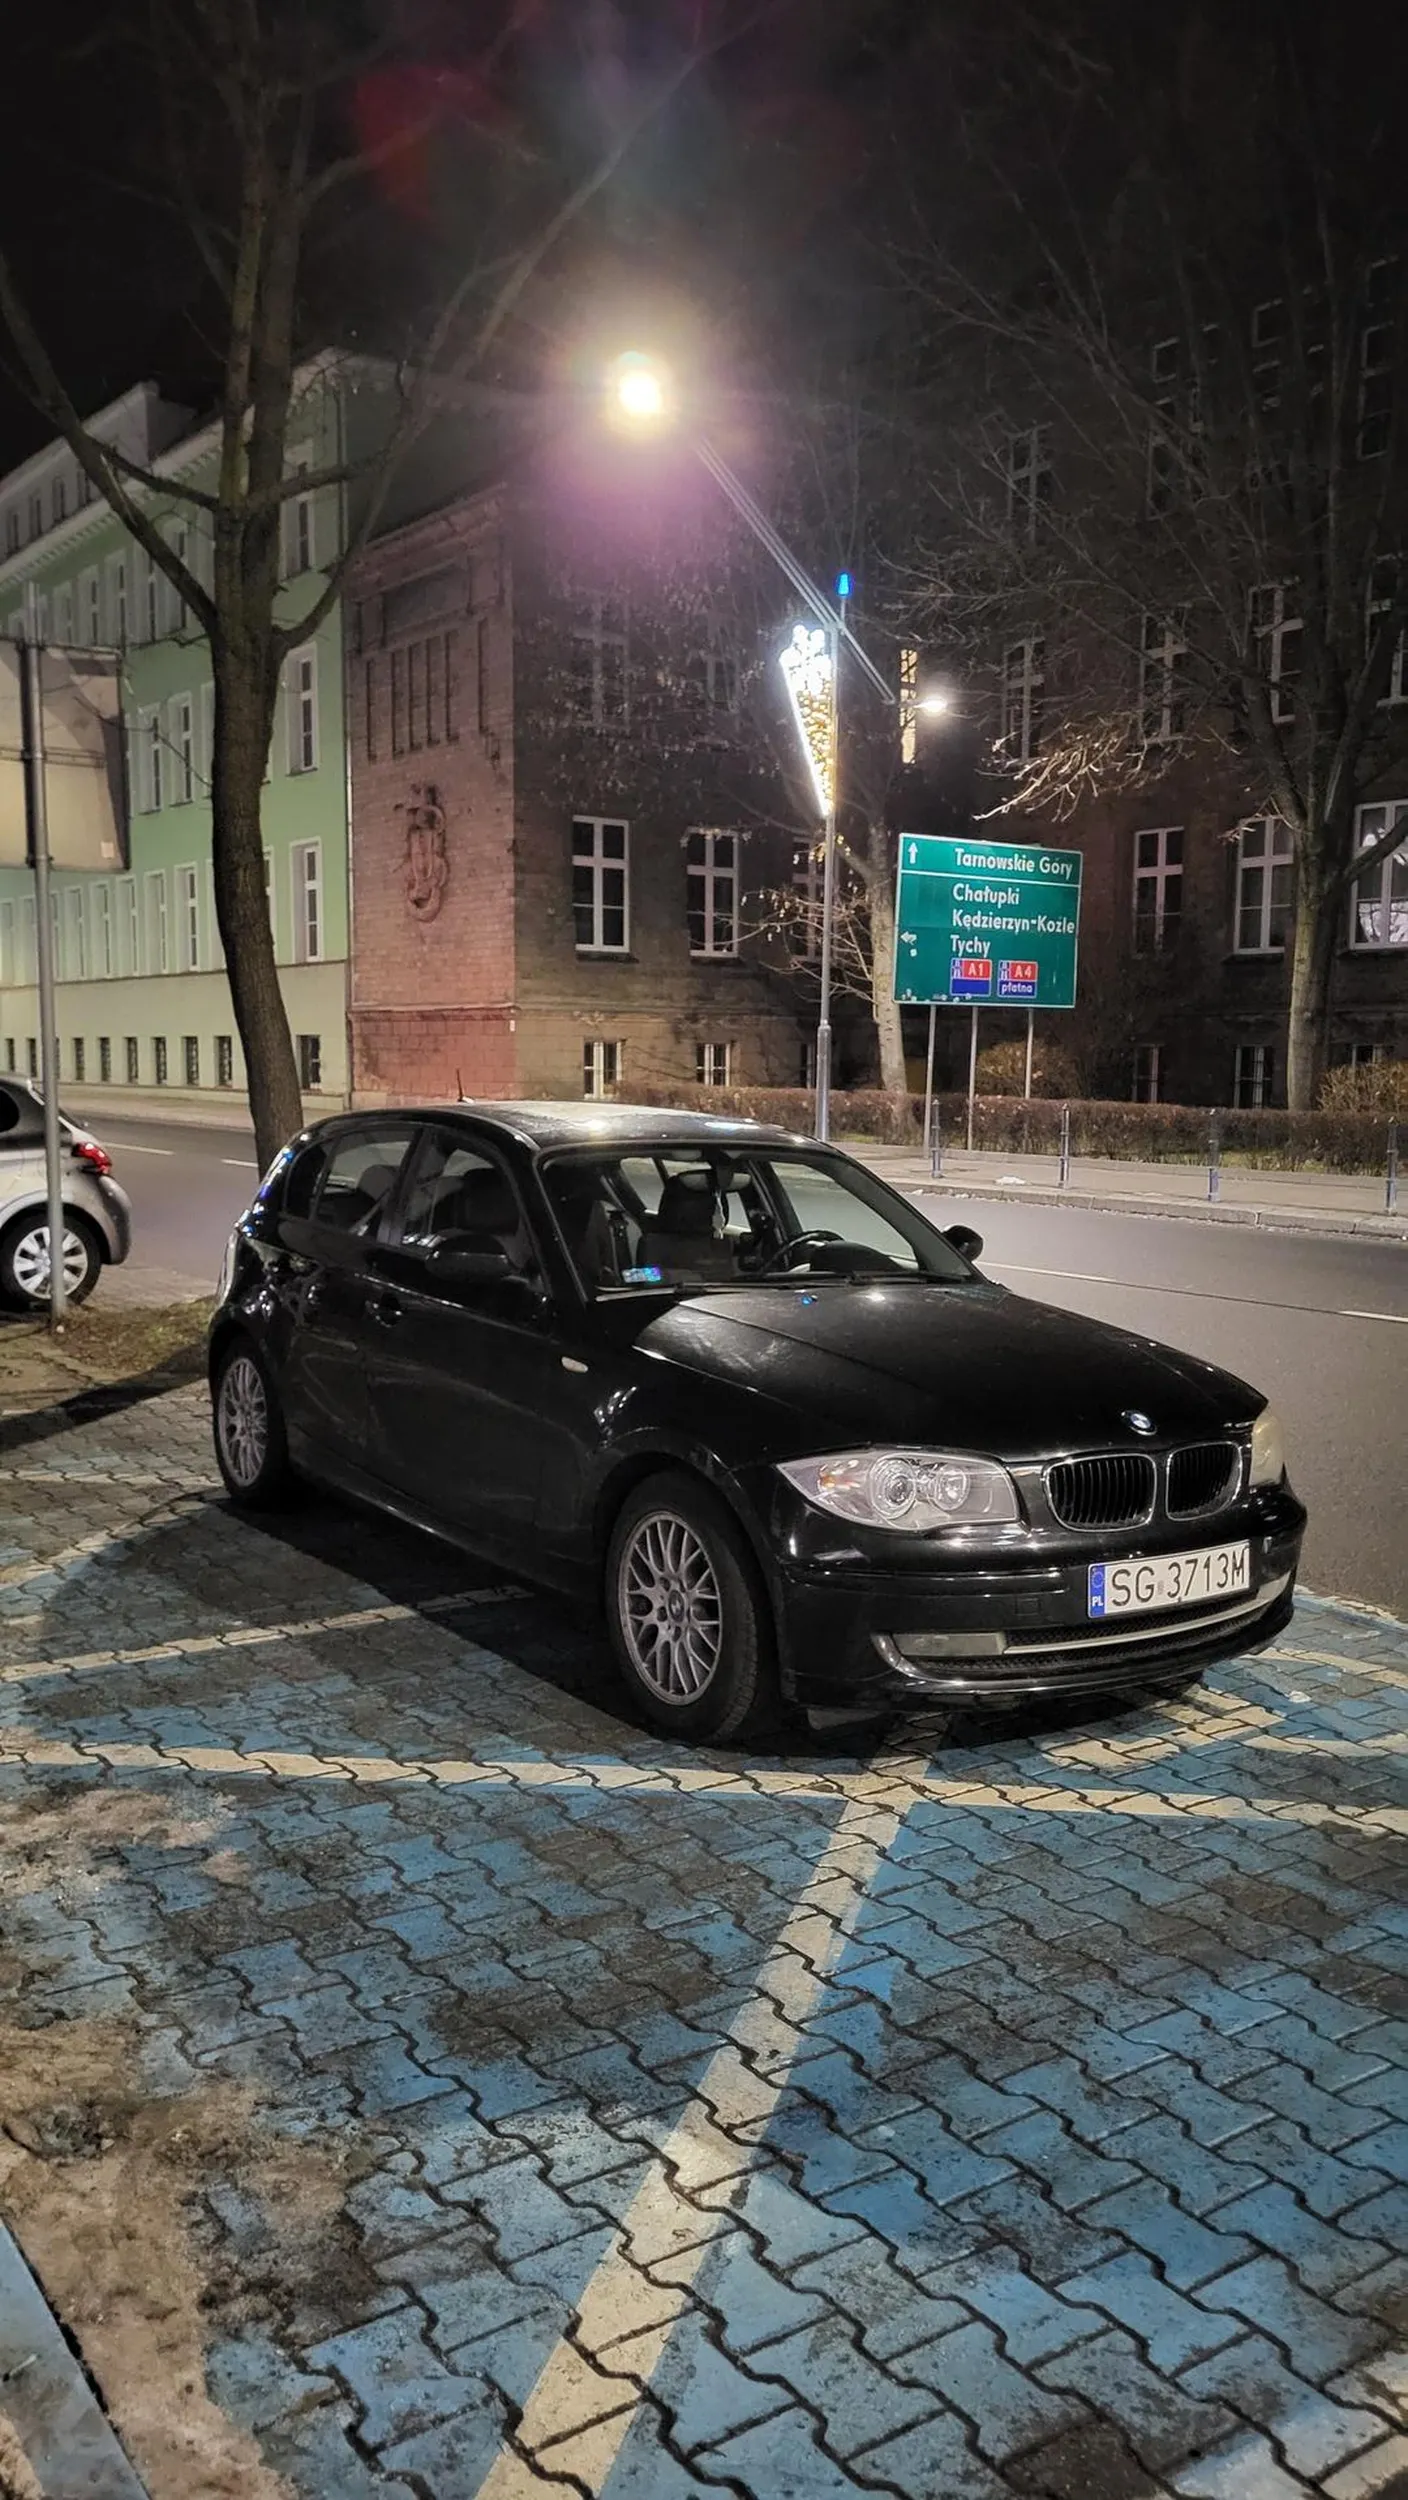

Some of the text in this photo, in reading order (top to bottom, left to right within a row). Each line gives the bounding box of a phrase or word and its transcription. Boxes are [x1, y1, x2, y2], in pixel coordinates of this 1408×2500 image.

[954, 848, 1073, 880] Tarnowskie Góry
[953, 883, 1020, 909] Chałupki
[952, 909, 1076, 935] Kędzierzyn-Koźle
[950, 934, 991, 958] Tychy
[968, 962, 984, 977] A1
[1014, 965, 1033, 979] A4
[1001, 982, 1033, 995] płatna
[1111, 1549, 1246, 1607] SG 3713M
[1092, 1596, 1104, 1607] PL
